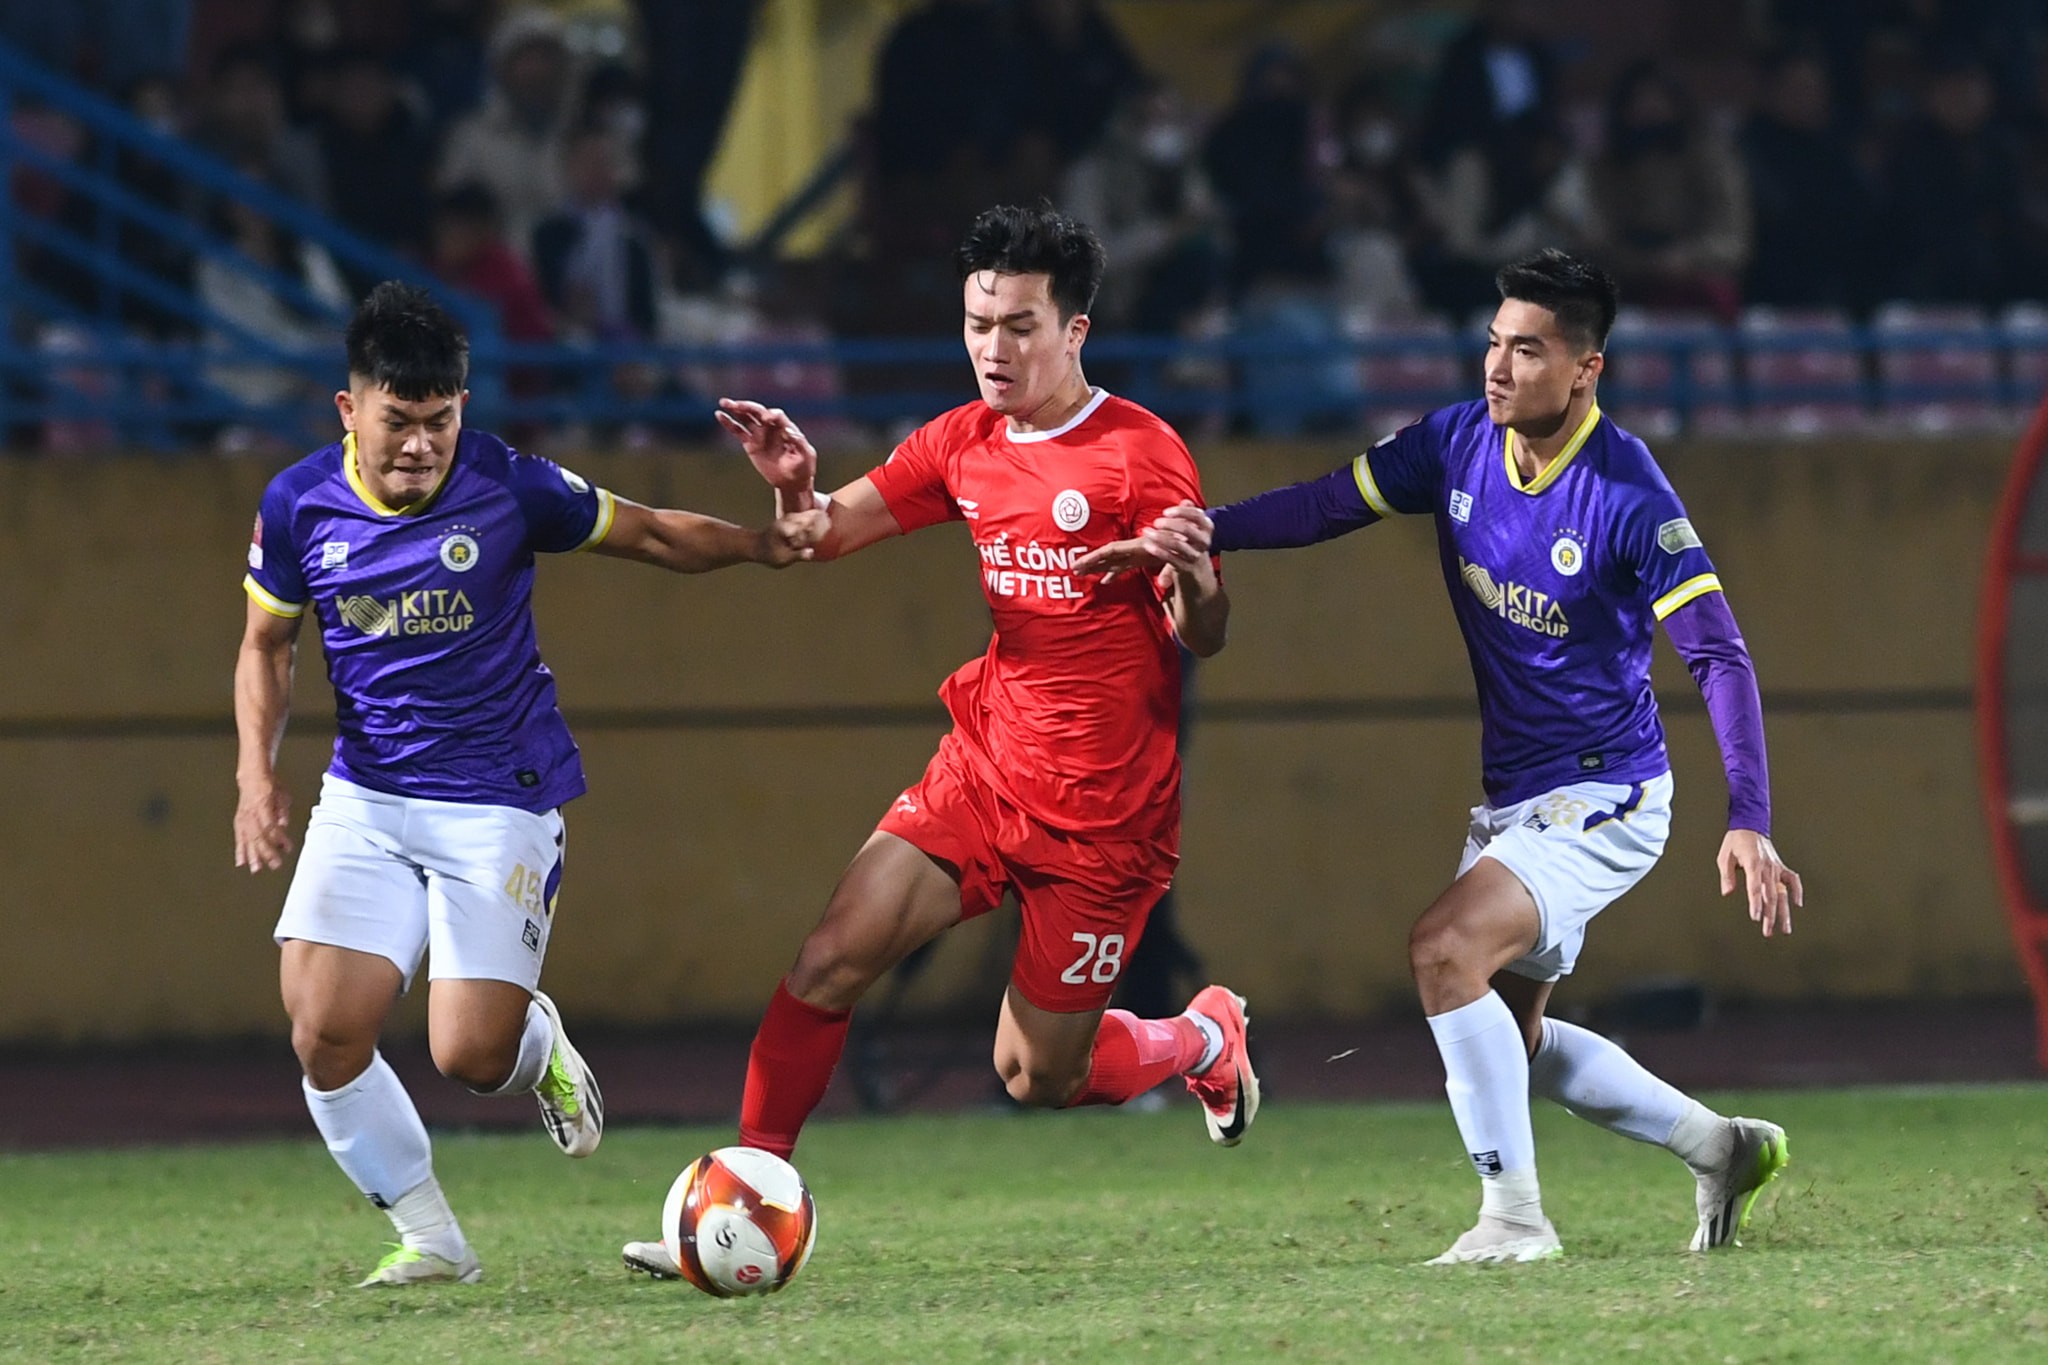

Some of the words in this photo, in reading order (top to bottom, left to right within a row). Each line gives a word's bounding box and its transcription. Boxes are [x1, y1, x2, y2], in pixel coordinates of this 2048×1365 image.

[983, 568, 1084, 599] VIETTEL
[402, 589, 473, 617] KITA
[1508, 581, 1569, 624] KITA
[404, 614, 474, 635] GROUP
[1508, 608, 1569, 638] GROUP
[1061, 932, 1124, 984] 28
